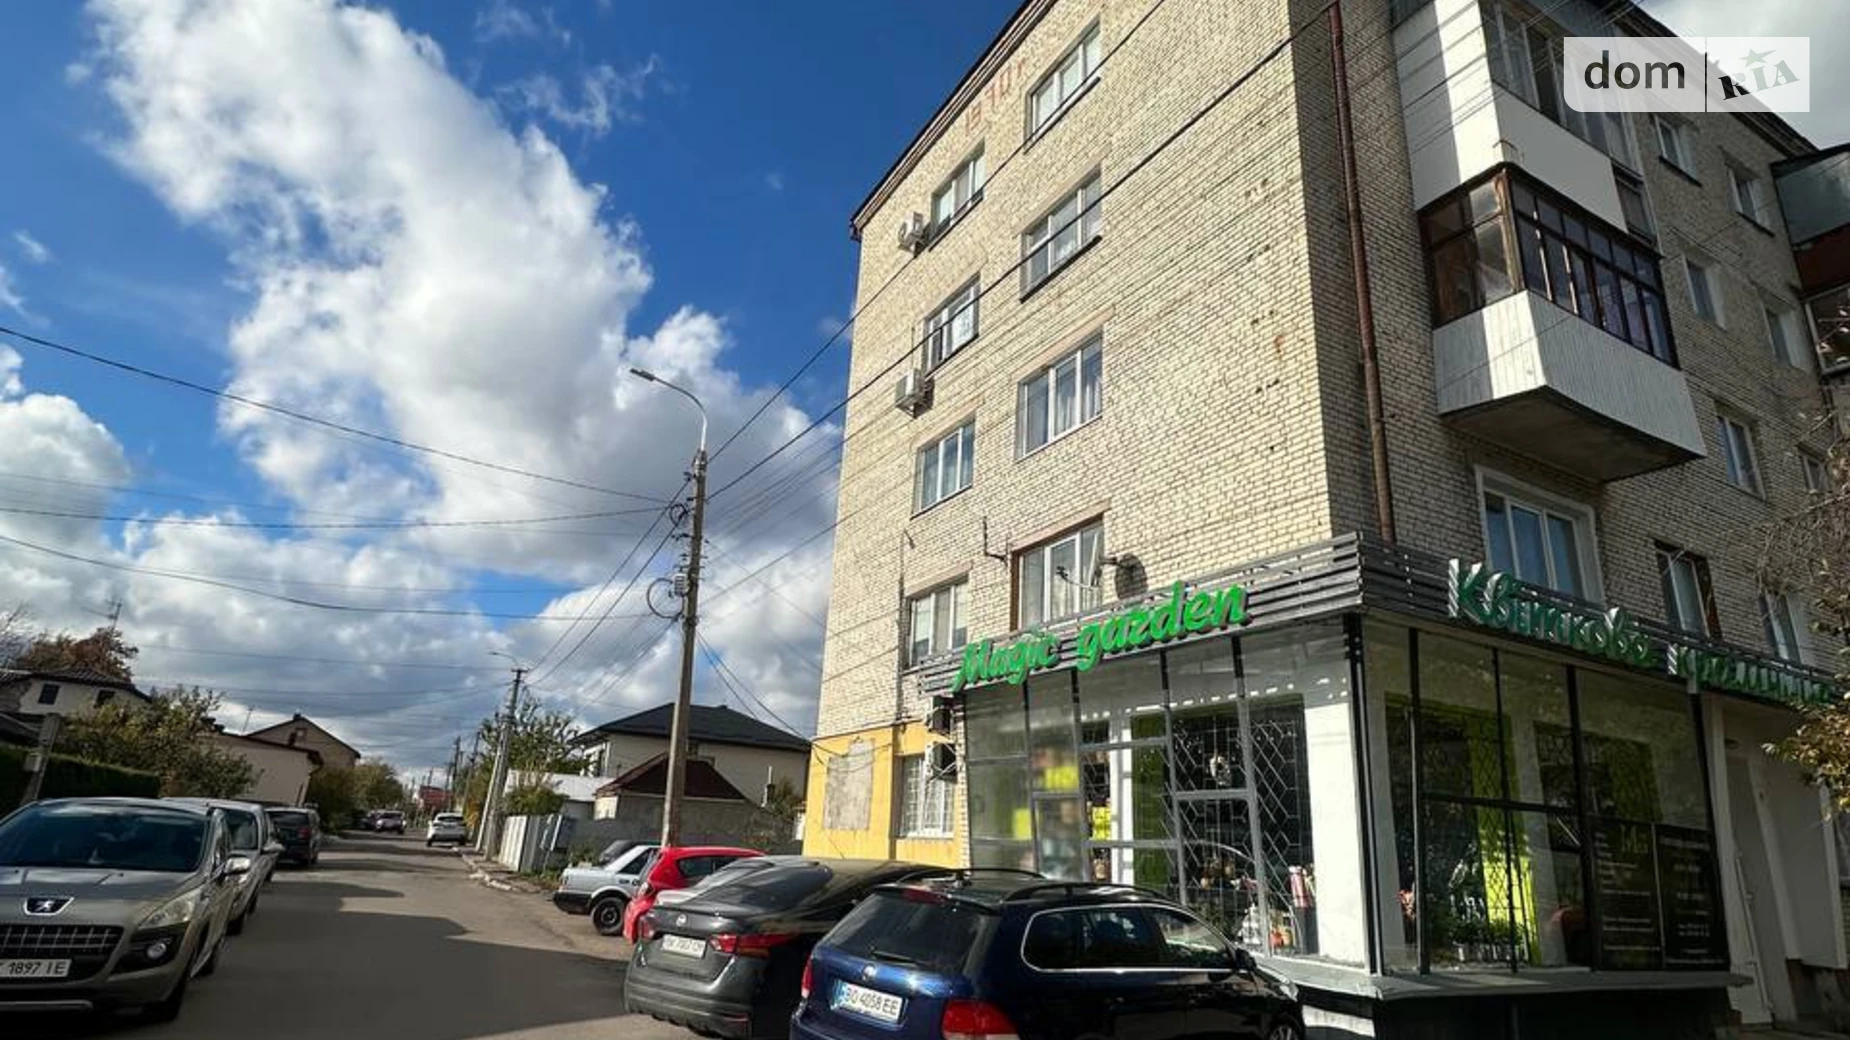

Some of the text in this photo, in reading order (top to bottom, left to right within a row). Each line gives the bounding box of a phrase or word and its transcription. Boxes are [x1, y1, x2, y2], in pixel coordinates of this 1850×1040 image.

[951, 631, 1057, 692] Magic
[8, 961, 41, 975] 1897
[882, 998, 899, 1016] EE
